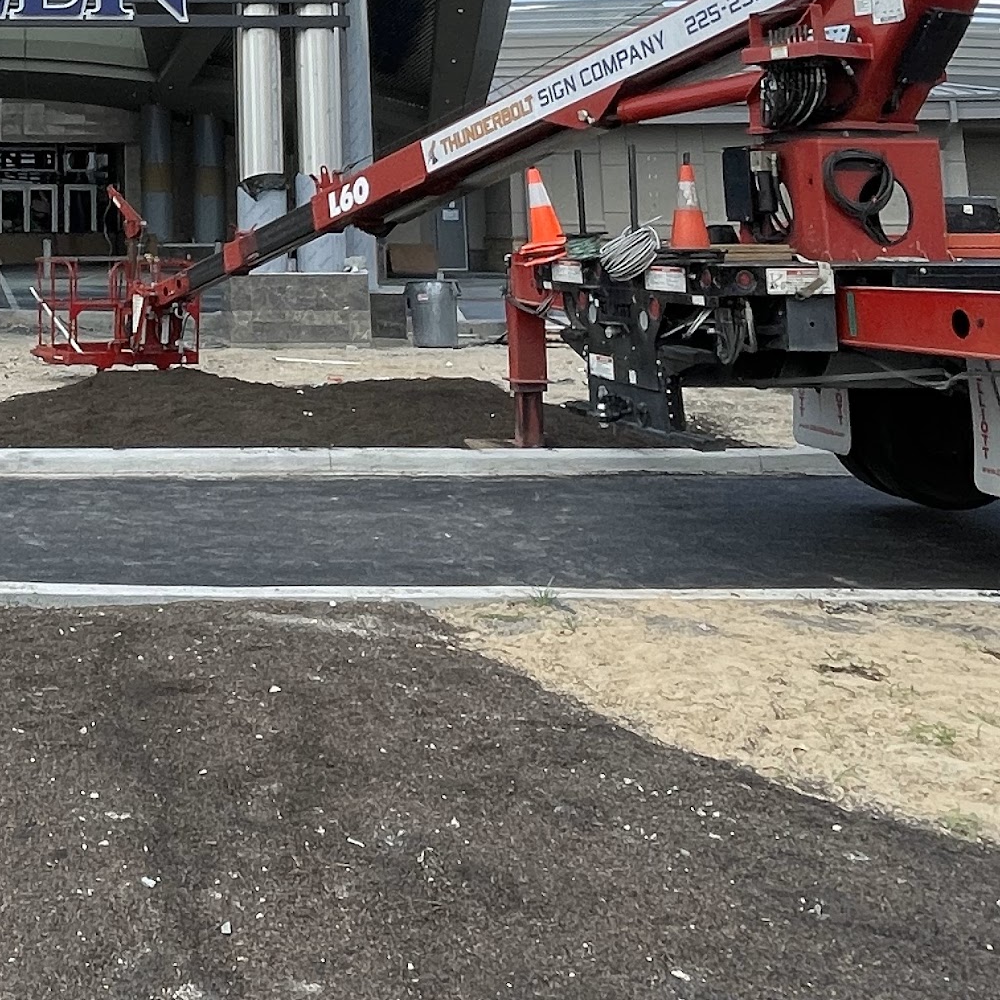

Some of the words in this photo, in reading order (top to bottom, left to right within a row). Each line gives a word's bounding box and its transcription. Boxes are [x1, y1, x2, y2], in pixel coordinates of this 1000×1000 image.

[440, 94, 534, 157] THUNDERBOLT
[537, 76, 577, 107] SIGN
[579, 30, 666, 87] COMPANY
[328, 176, 369, 219] L60
